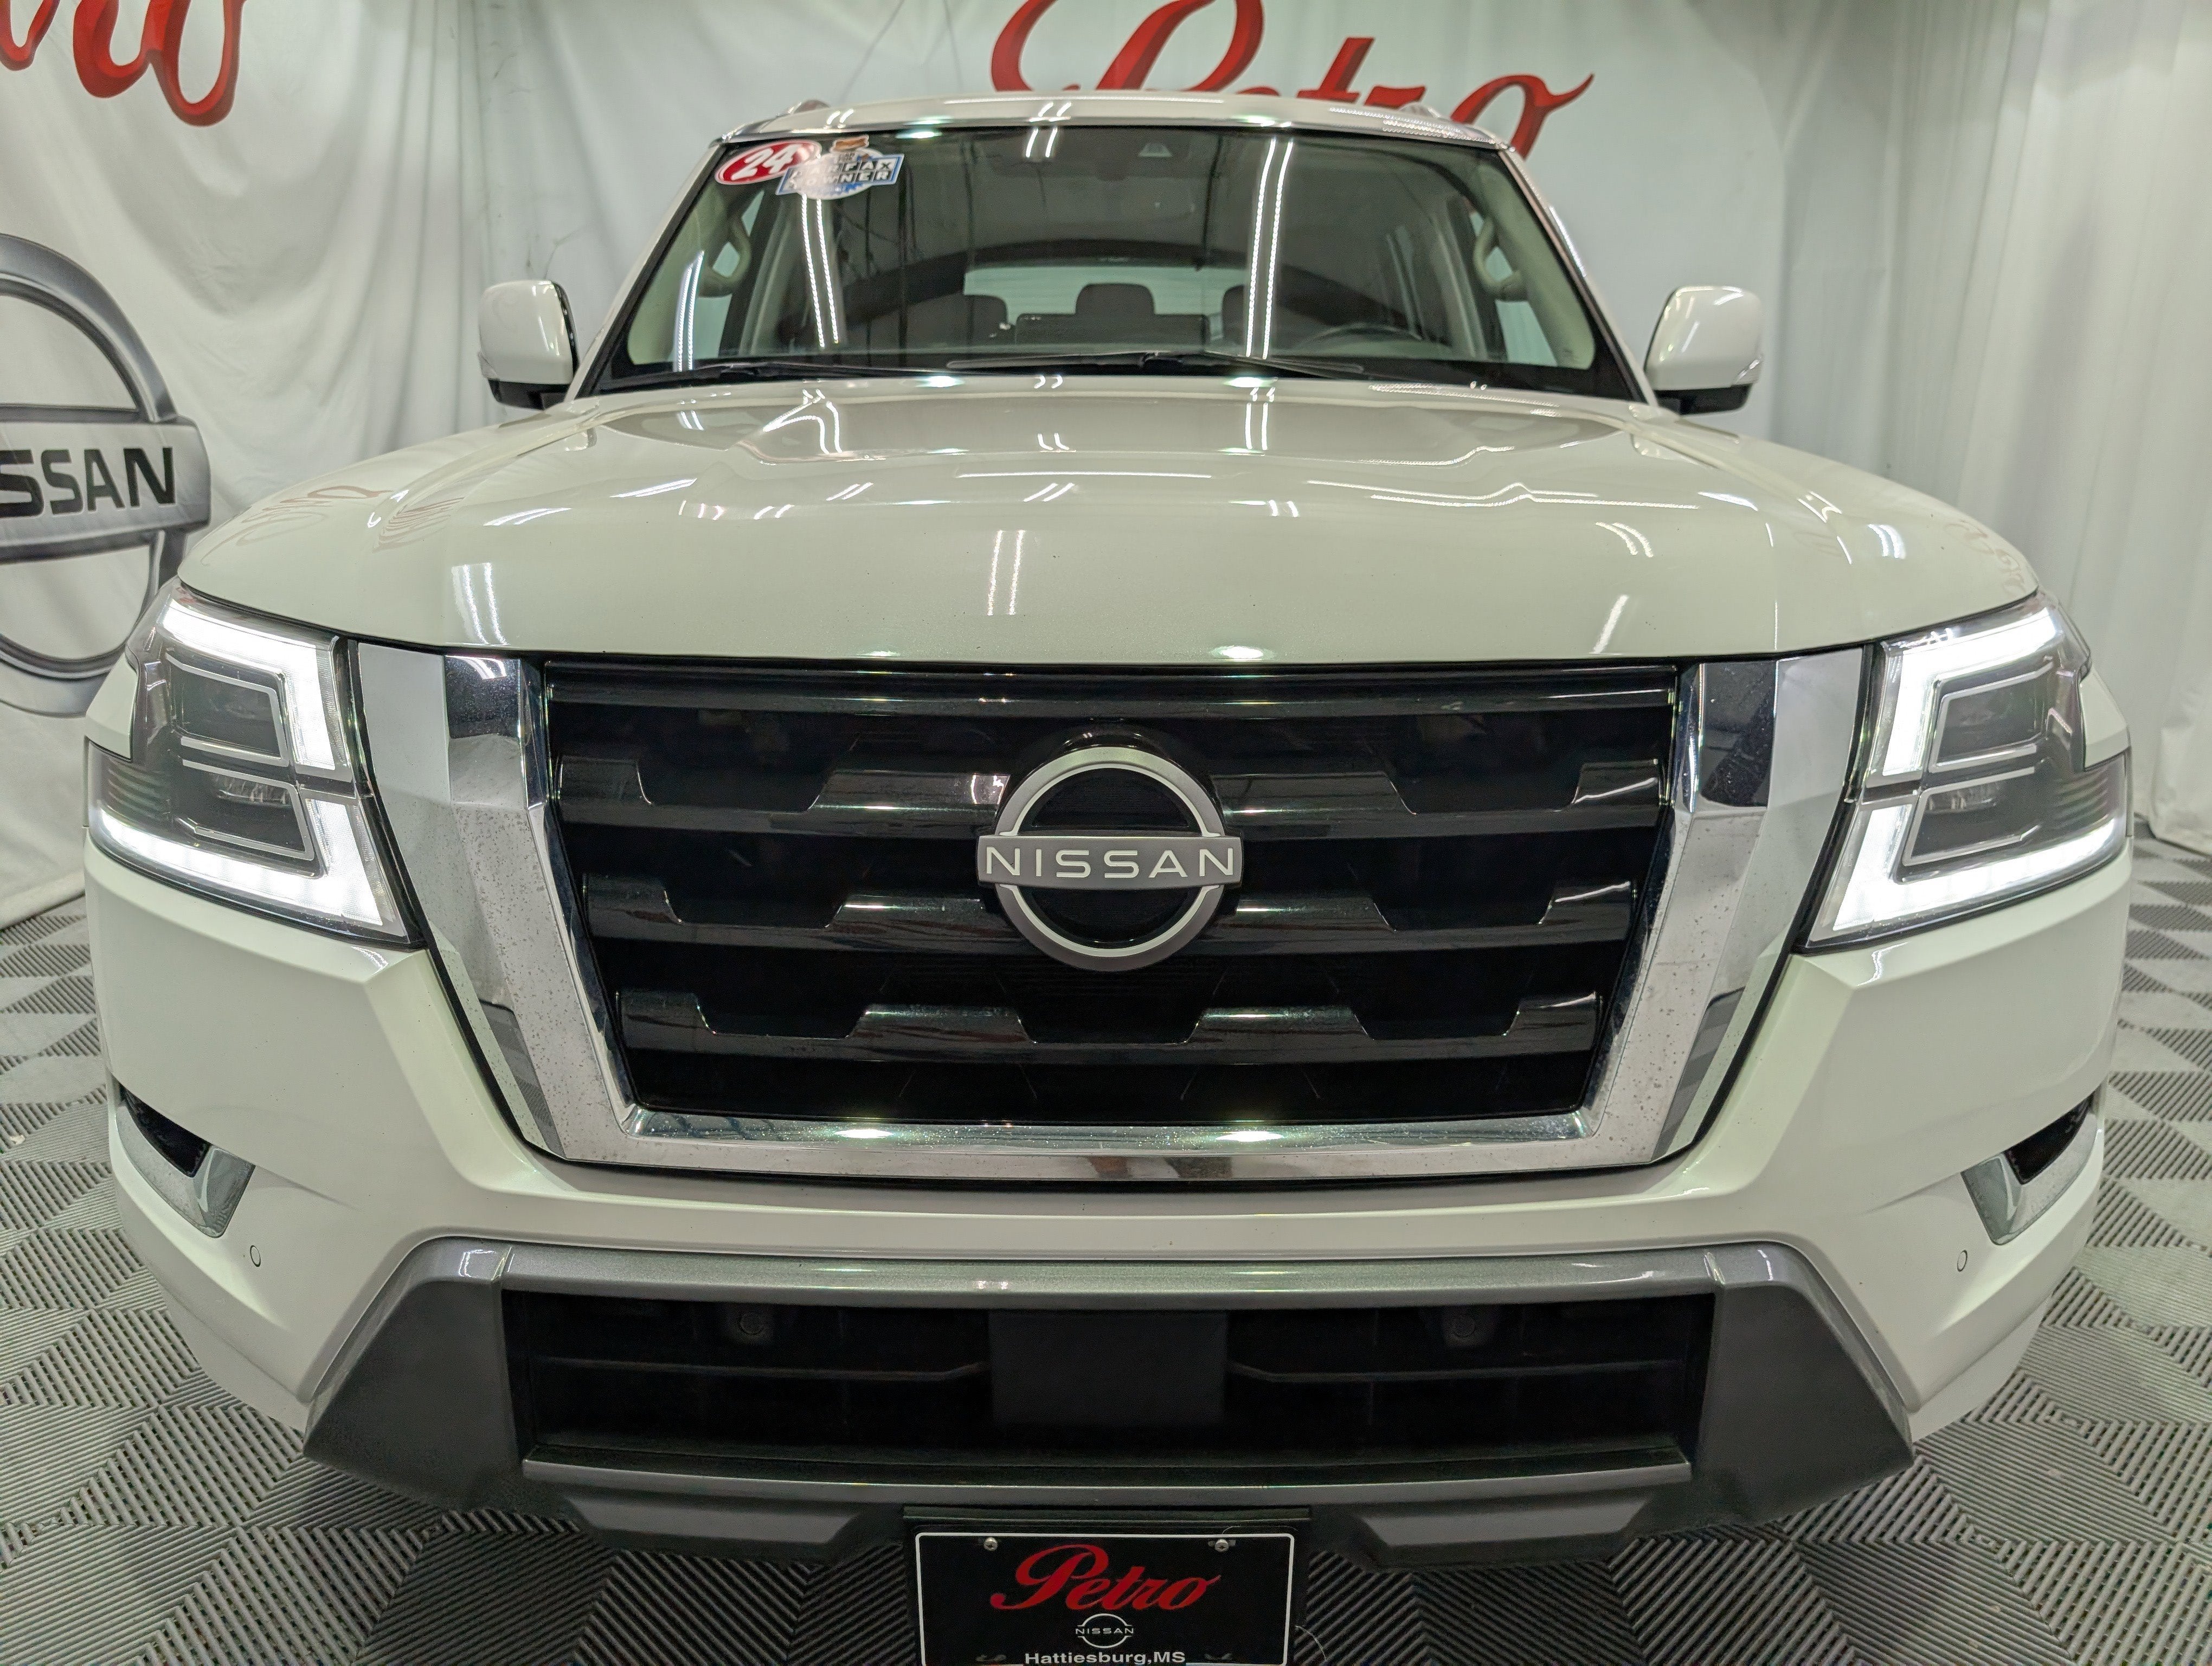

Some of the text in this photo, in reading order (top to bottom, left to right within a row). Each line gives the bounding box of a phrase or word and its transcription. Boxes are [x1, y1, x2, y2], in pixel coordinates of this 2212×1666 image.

[730, 144, 803, 181] 24
[986, 846, 1233, 879] NISSAN
[990, 1543, 1221, 1610] Petro
